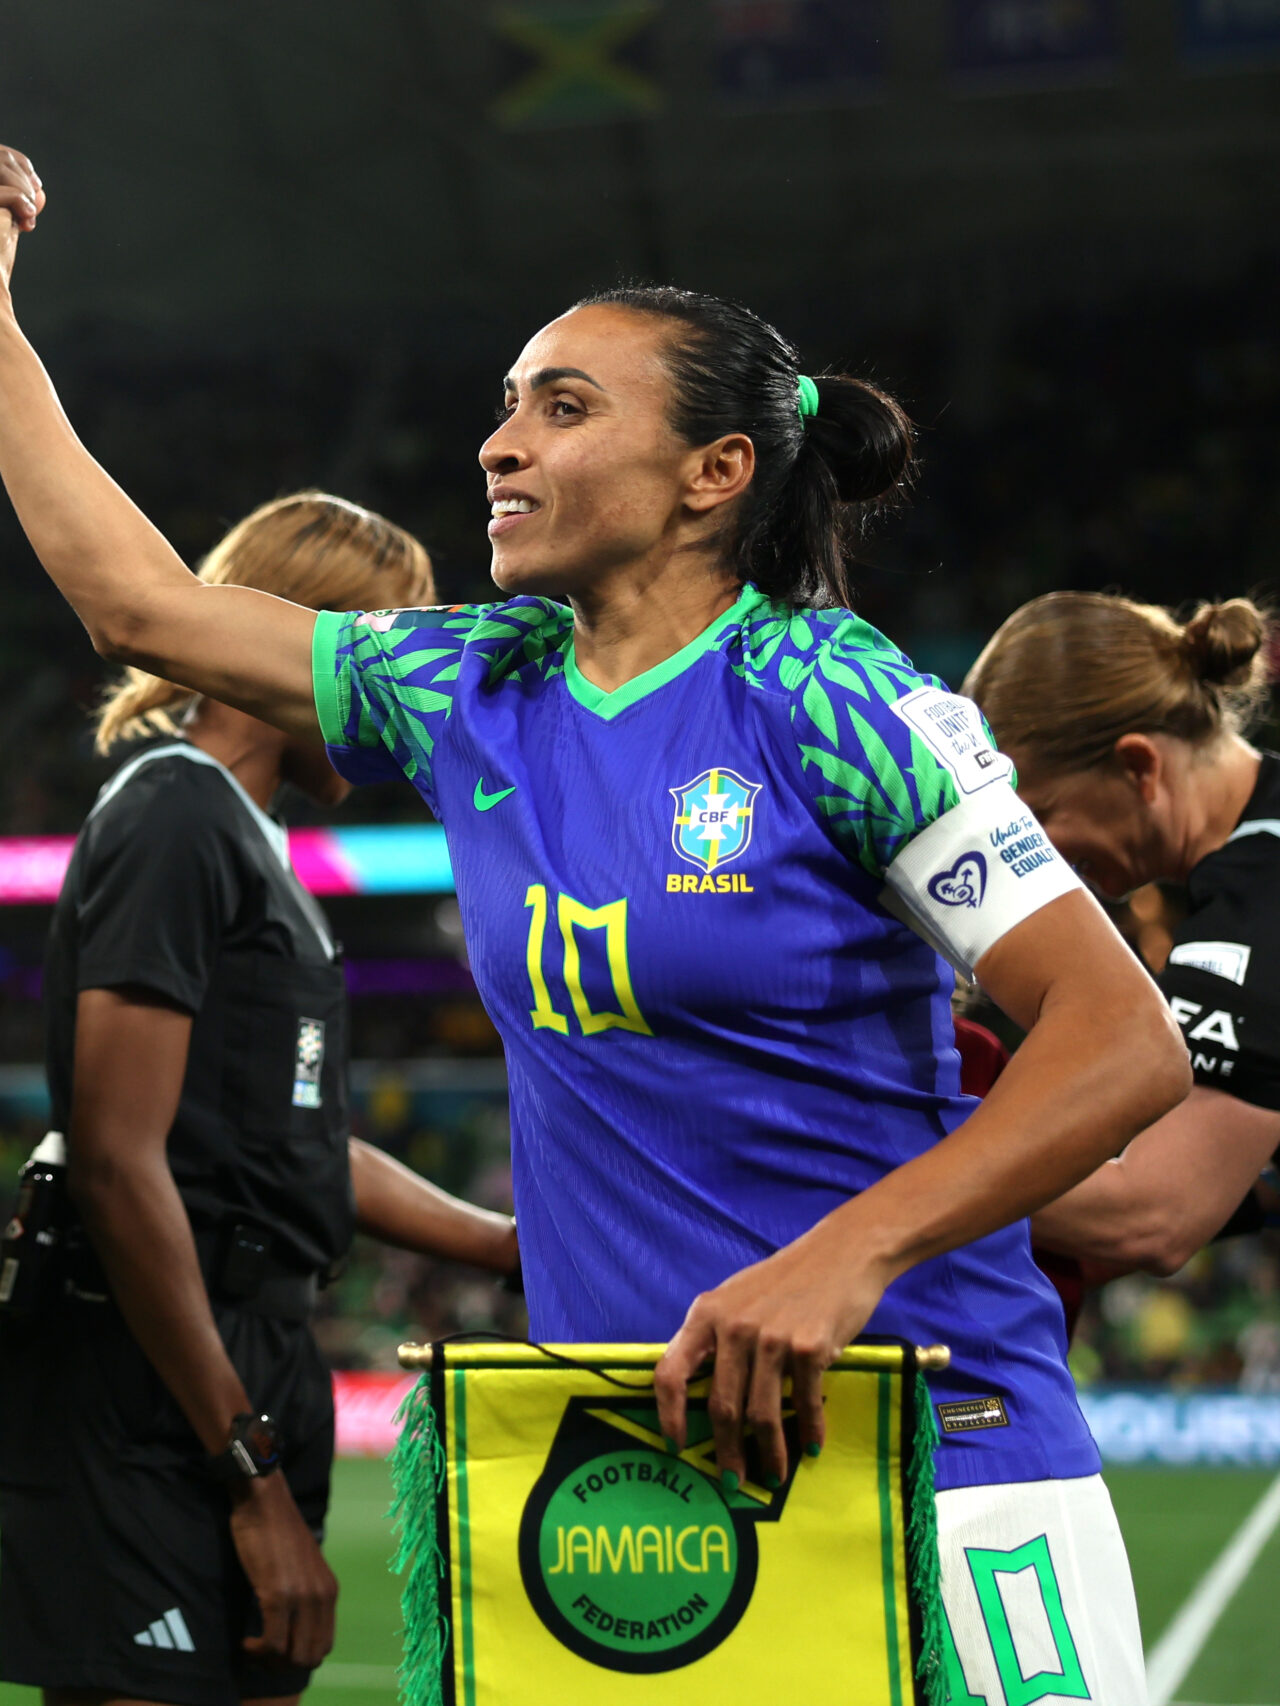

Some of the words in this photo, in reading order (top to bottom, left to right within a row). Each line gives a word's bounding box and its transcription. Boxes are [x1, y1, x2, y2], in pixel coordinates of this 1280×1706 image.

[935, 710, 970, 738] UNIT
[699, 811, 729, 823] CBF
[989, 821, 1022, 848] Unite
[1019, 815, 1033, 831] Fo
[999, 833, 1045, 864] GENDER
[1010, 847, 1057, 879] EQUALIT
[666, 873, 755, 893] BRASIL
[524, 883, 656, 1037] 10
[572, 1462, 695, 1504] FOOTBALL
[548, 1525, 730, 1575] JAMAICA
[571, 1592, 710, 1641] FEDERATION
